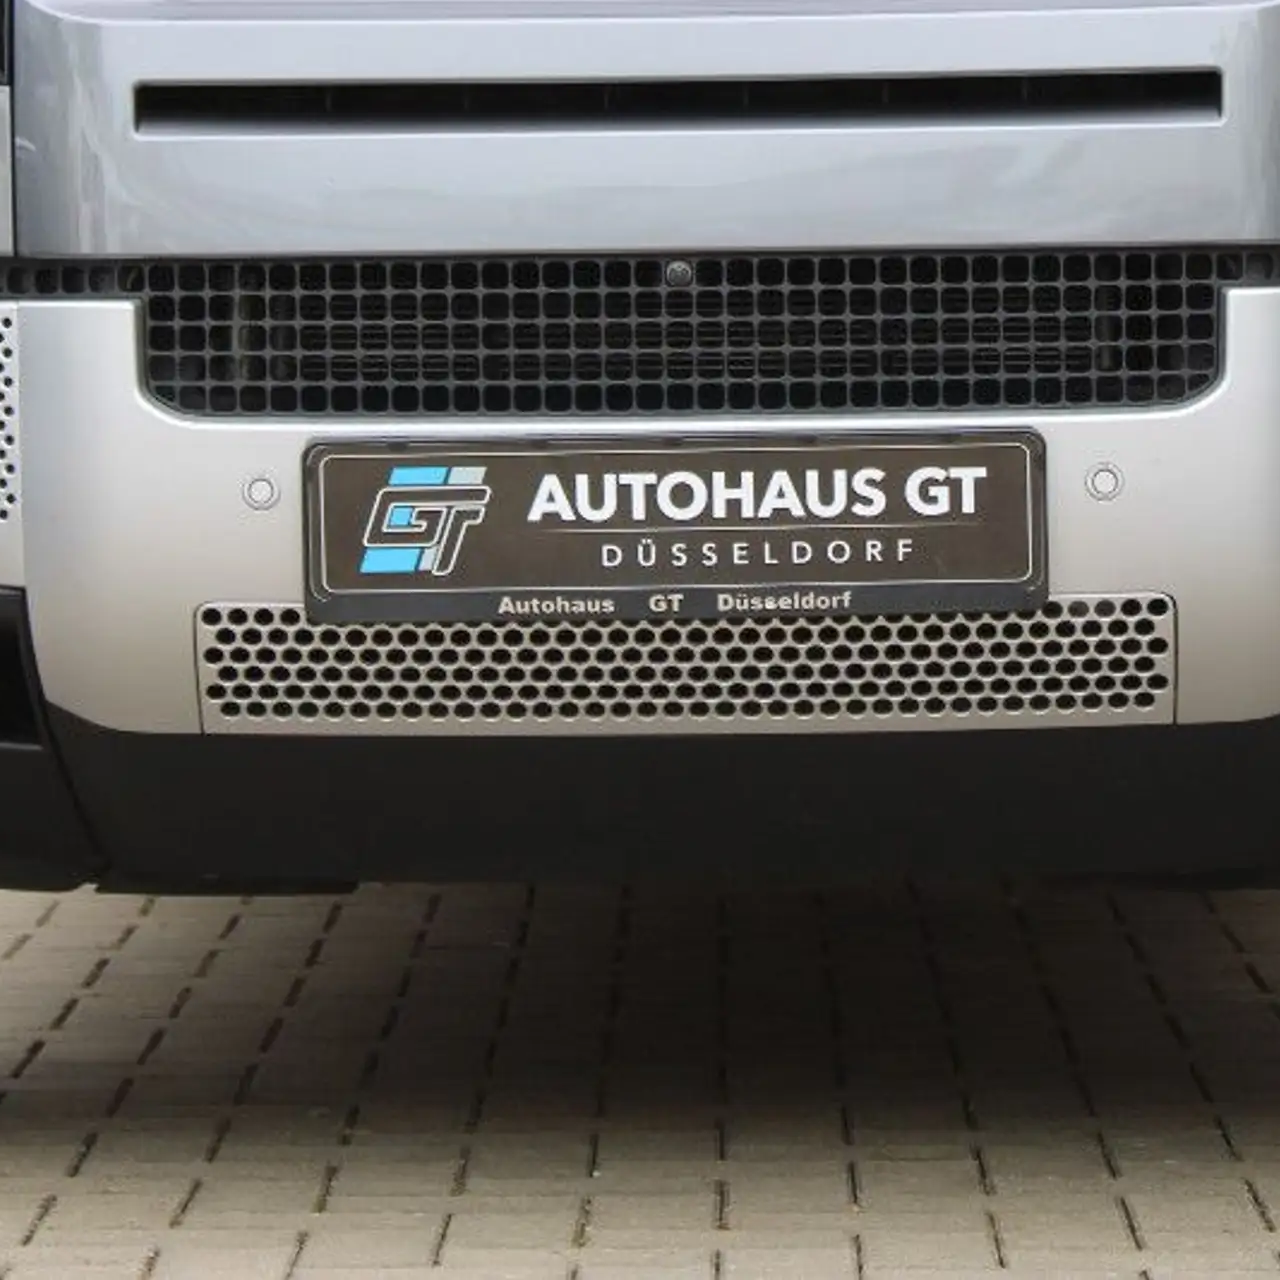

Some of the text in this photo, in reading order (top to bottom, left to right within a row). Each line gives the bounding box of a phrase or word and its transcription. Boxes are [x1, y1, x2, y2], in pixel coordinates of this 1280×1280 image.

[527, 466, 987, 522] AUTOHAUS GT
[601, 538, 914, 568] DÜSSELDORF
[498, 590, 853, 615] Autohaus GT Düsseldorf
